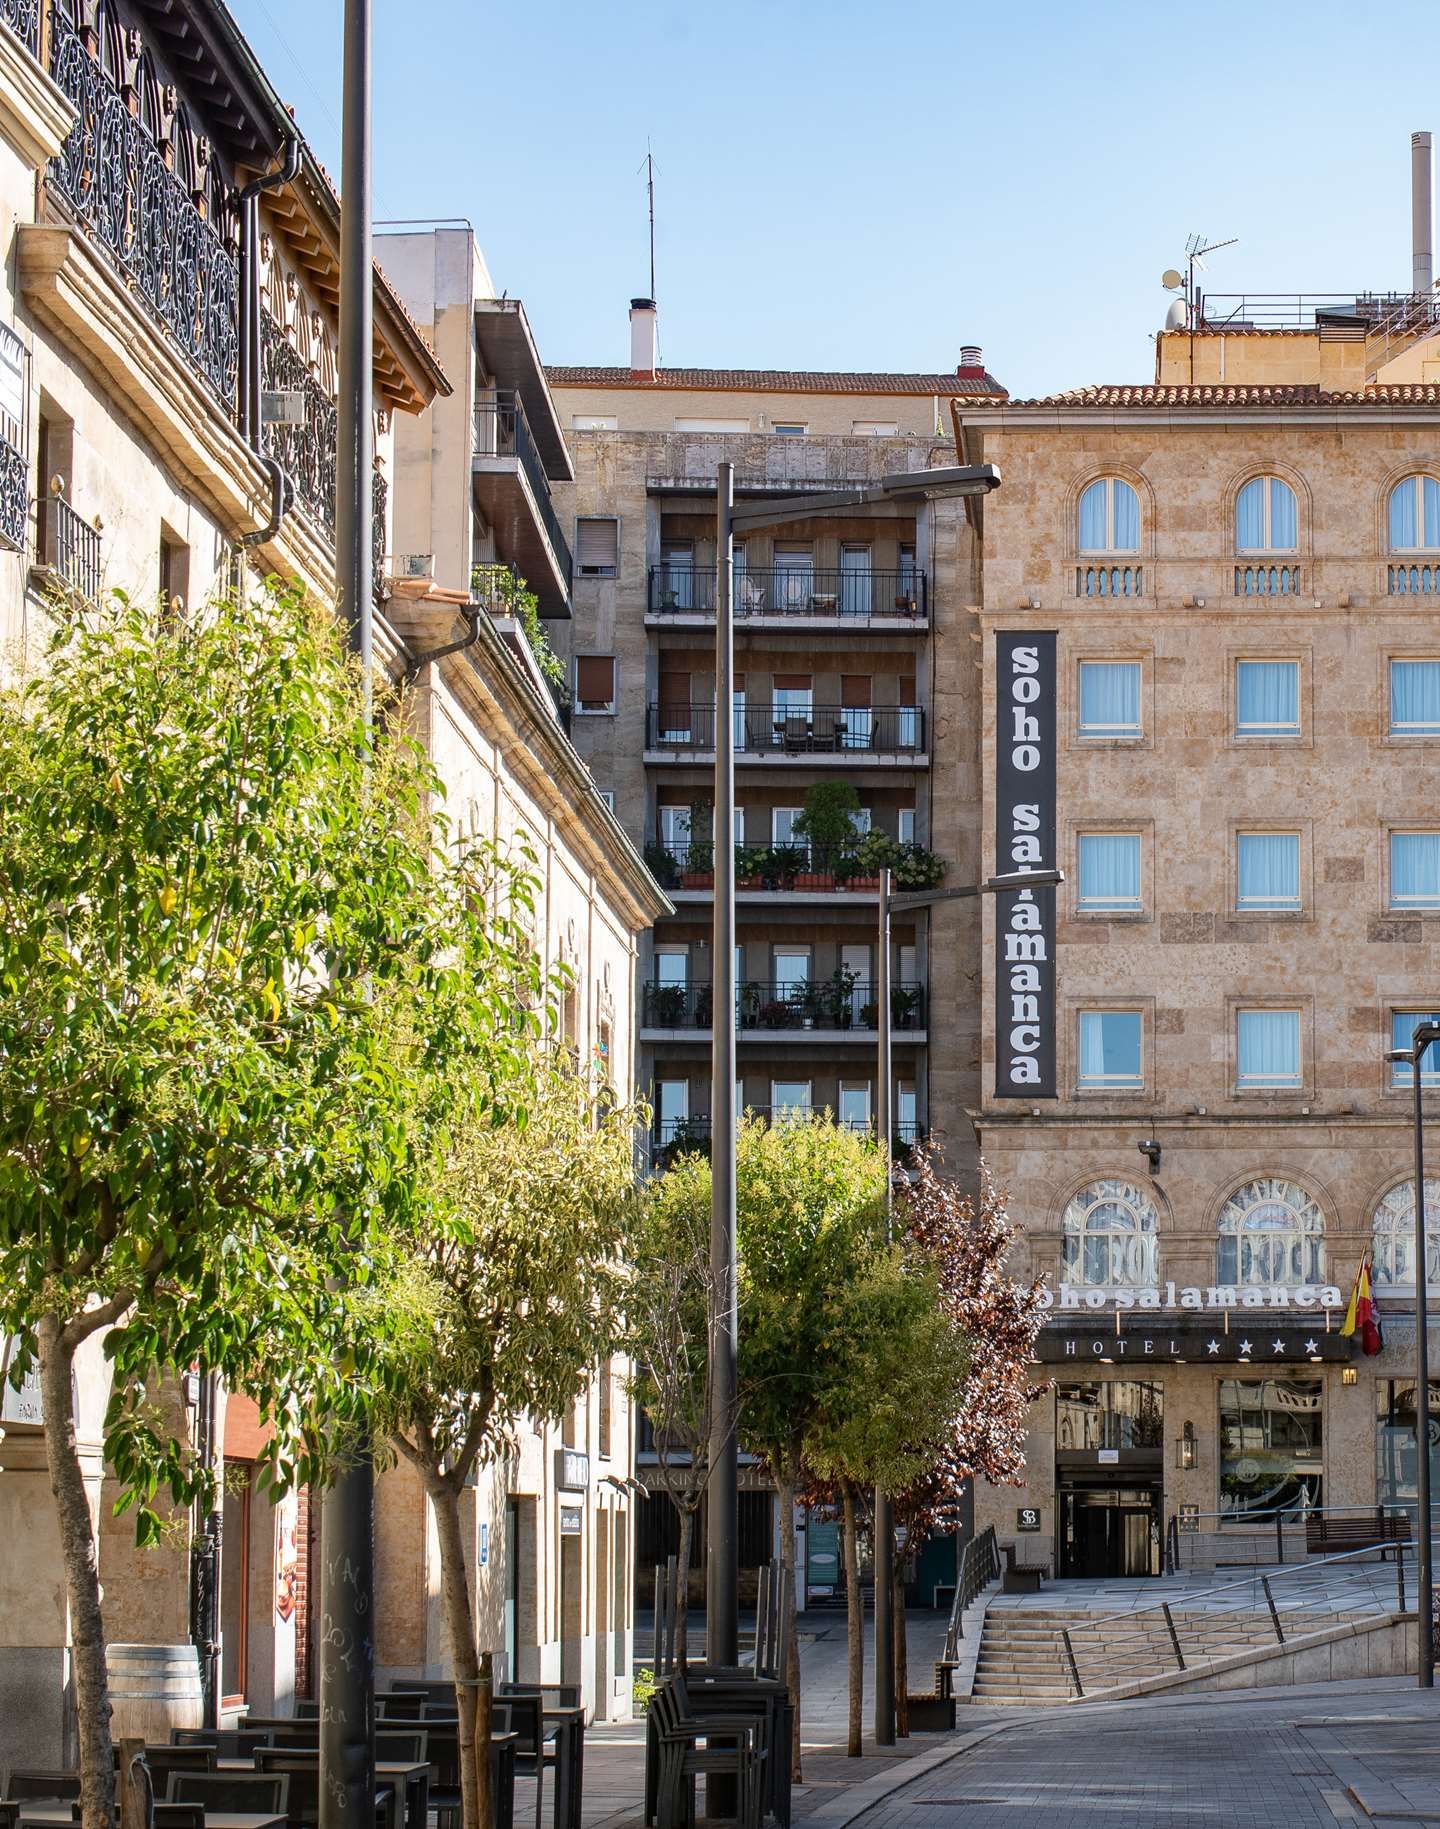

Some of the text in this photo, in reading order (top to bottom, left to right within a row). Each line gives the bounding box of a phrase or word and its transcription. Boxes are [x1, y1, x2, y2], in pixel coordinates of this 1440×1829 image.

[1004, 646, 1047, 1084] soho salamanca
[1034, 1282, 1343, 1311] ohosalamanca
[1065, 1340, 1180, 1355] HOTEL
